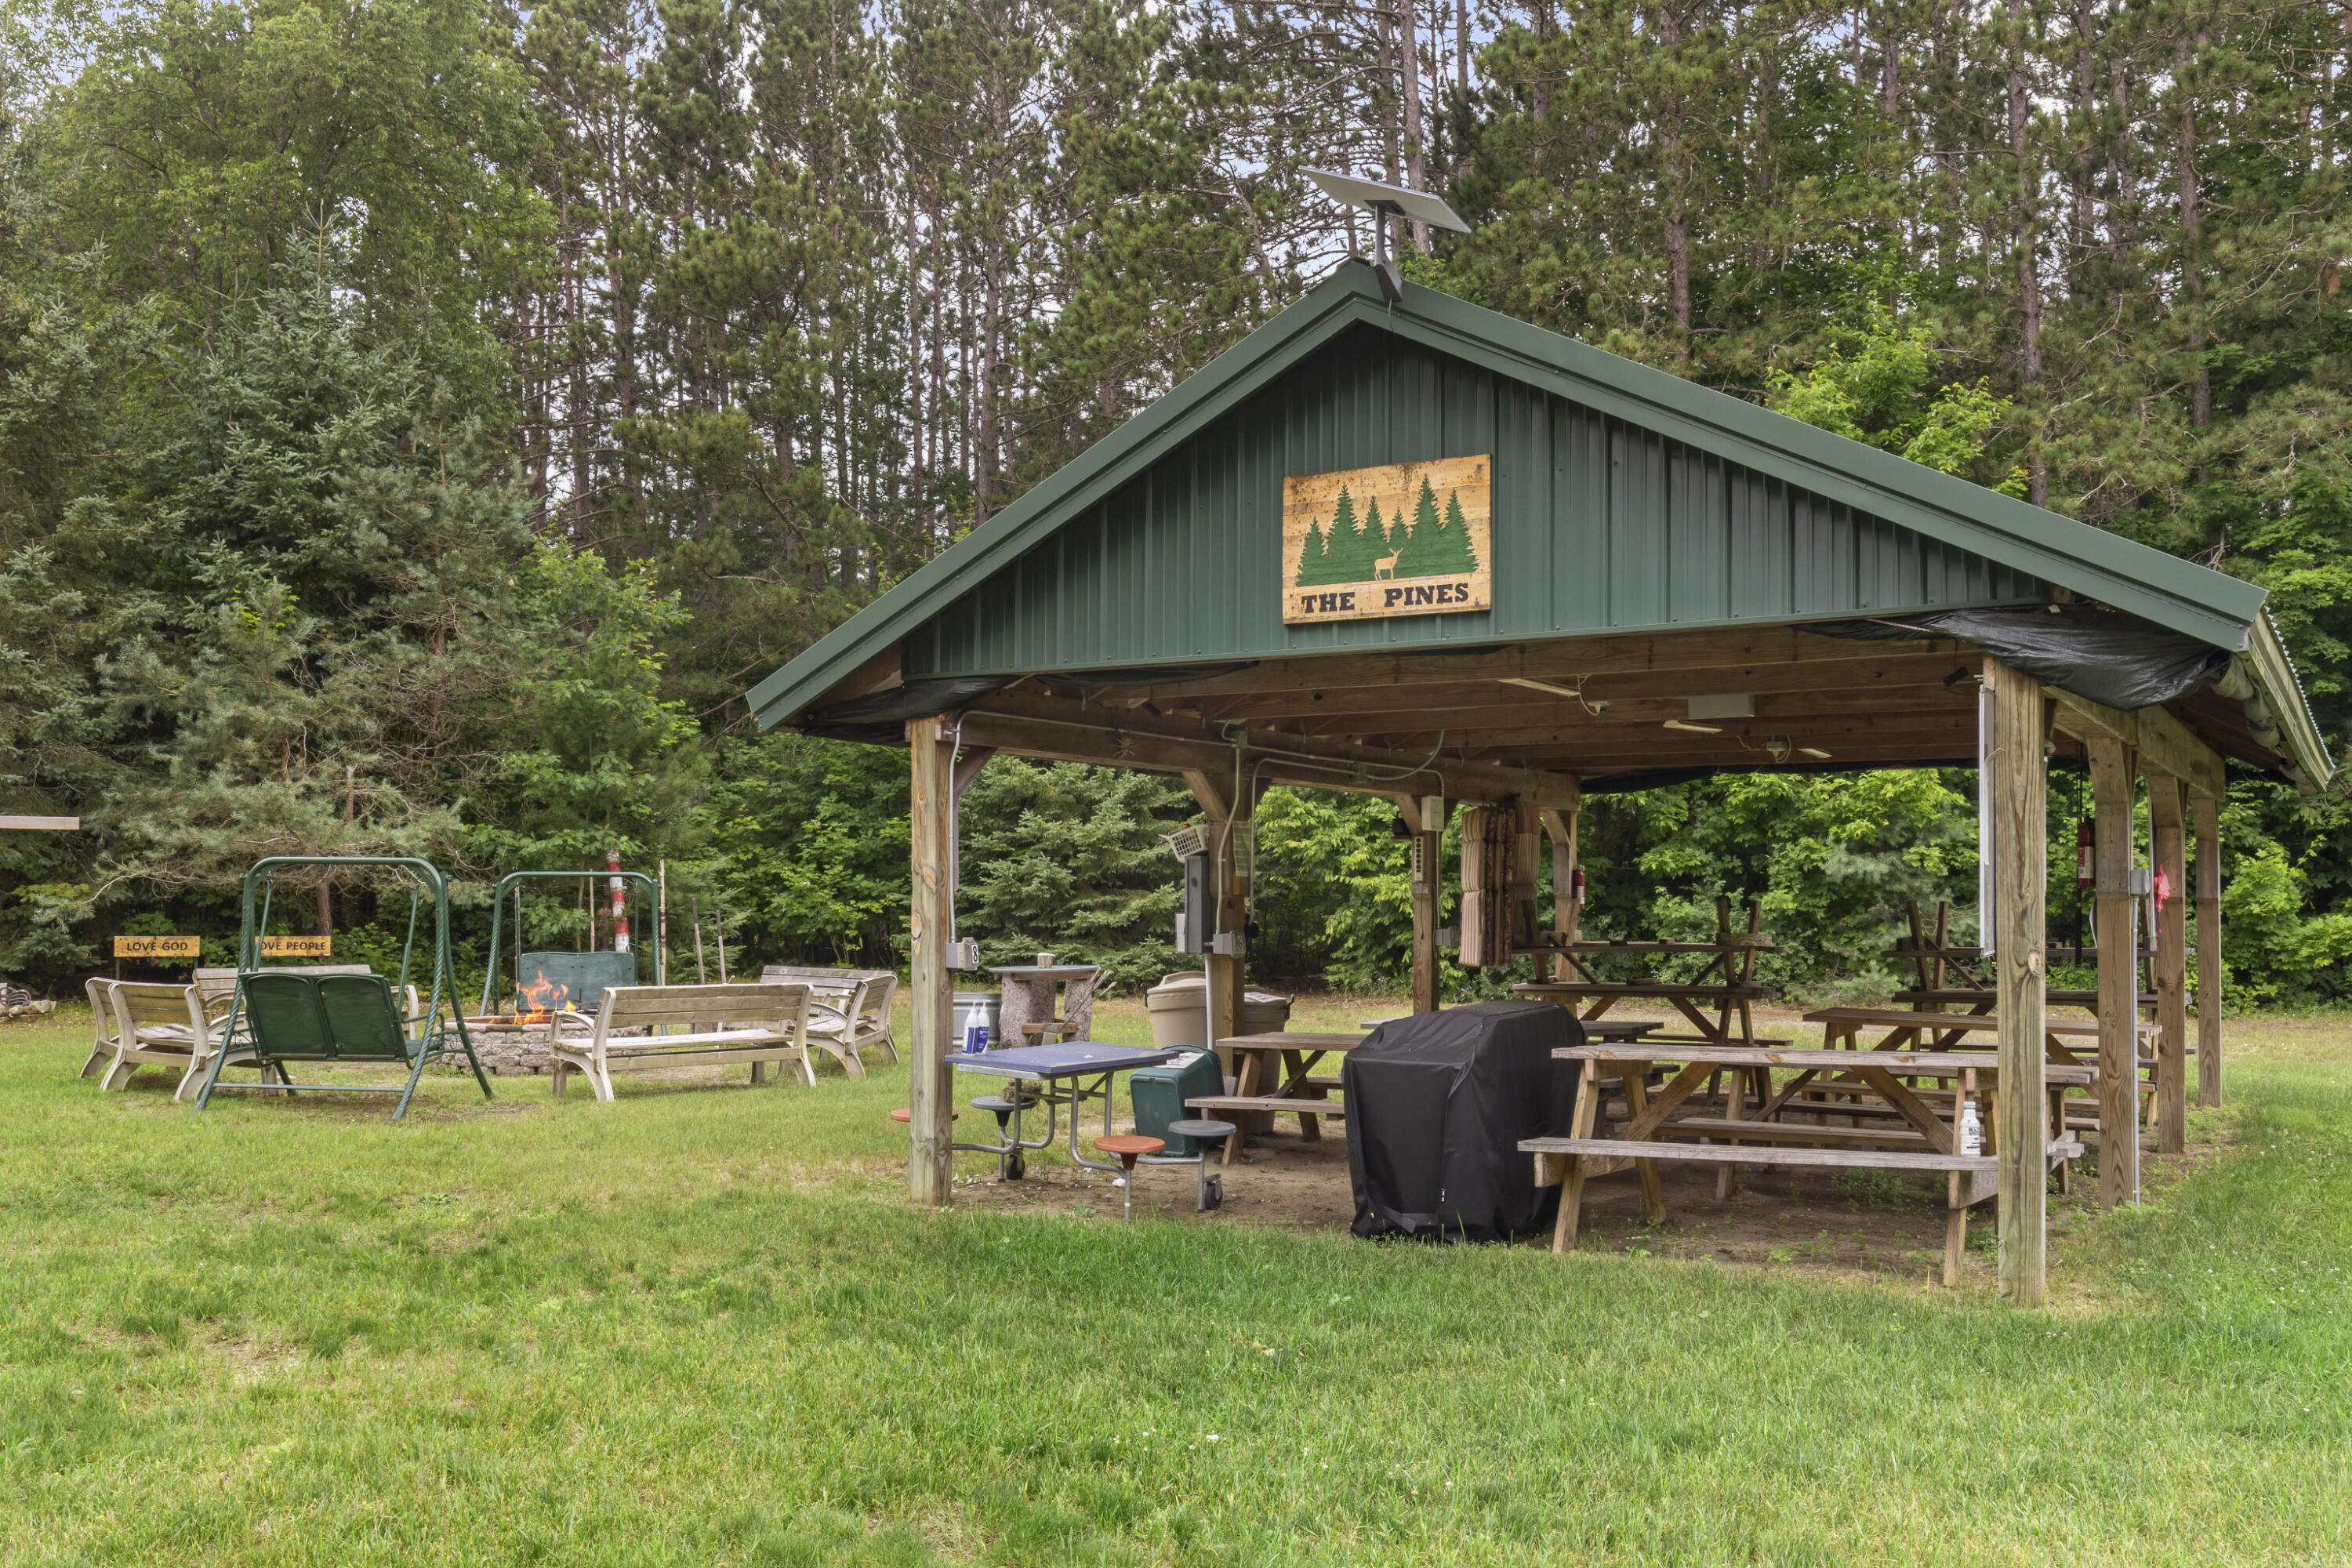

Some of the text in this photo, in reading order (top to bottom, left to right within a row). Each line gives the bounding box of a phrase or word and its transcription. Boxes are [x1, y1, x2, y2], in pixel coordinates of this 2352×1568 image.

[1301, 583, 1468, 613] THE PINES
[126, 942, 187, 951] LOVE GOD
[261, 942, 326, 950] OVE PEOPLE
[973, 946, 978, 963] 8
